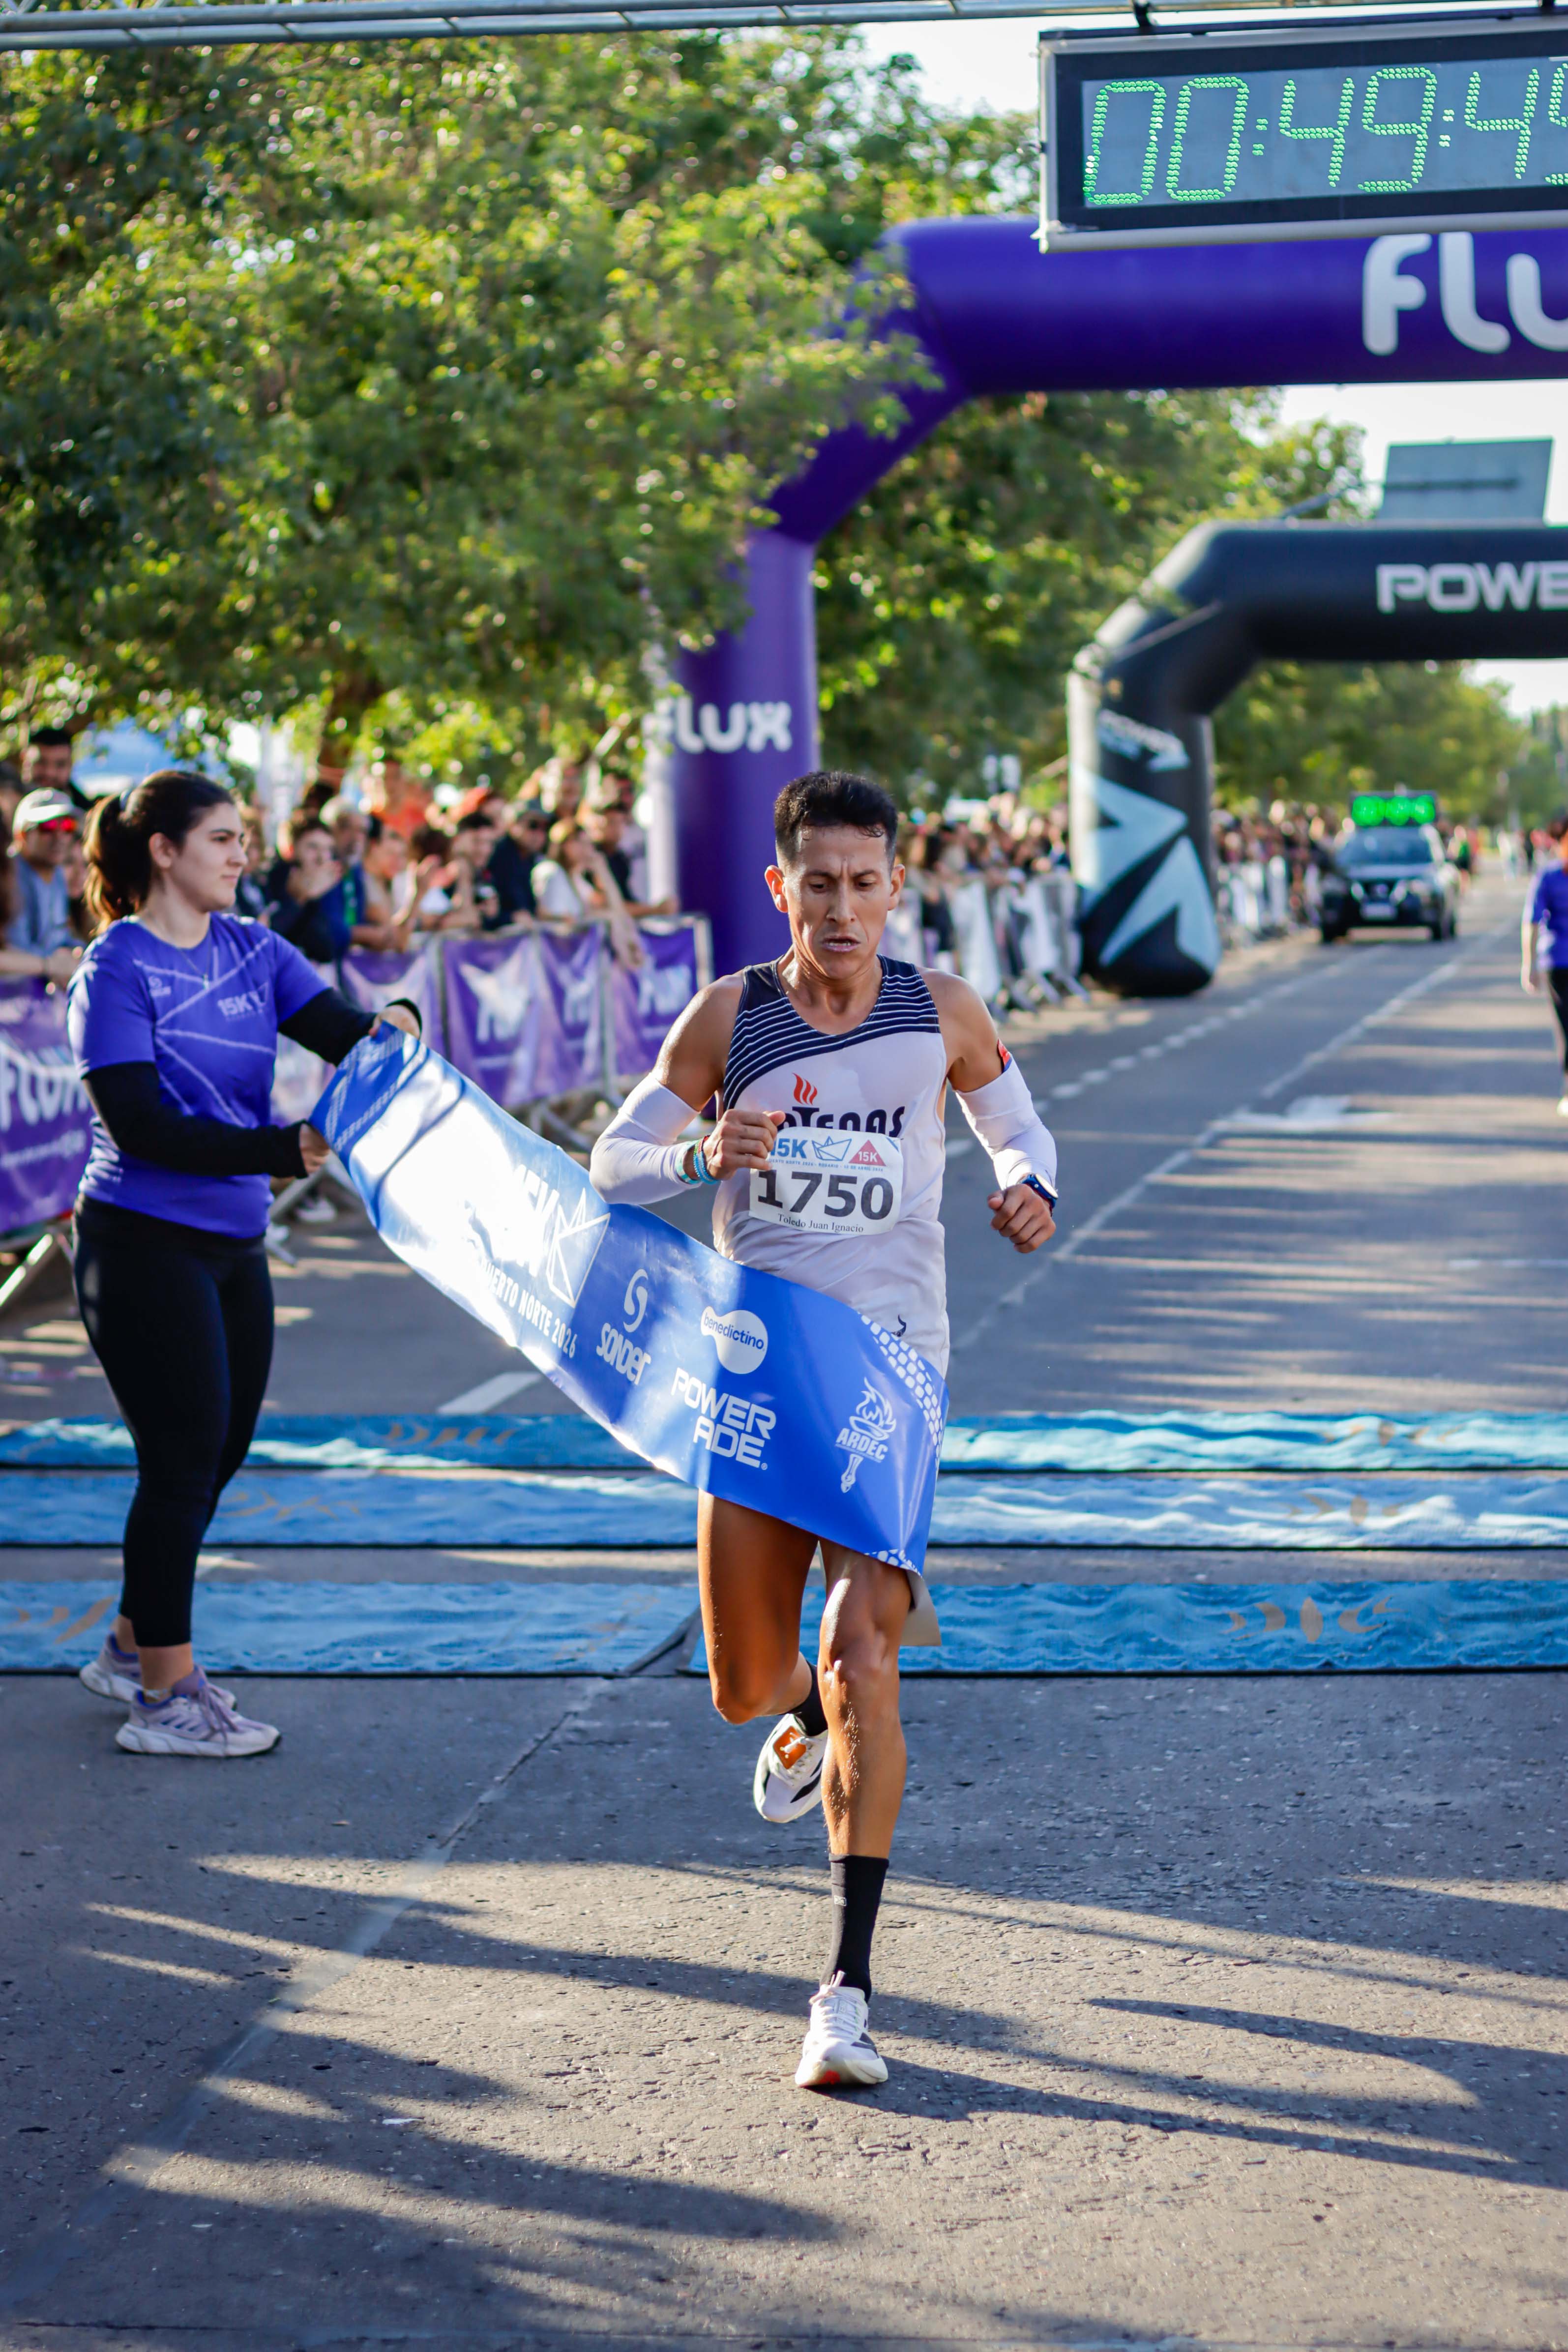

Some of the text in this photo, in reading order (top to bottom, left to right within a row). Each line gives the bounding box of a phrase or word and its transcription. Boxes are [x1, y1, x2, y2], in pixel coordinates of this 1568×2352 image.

[858, 1151, 878, 1163] 15K
[757, 1170, 894, 1220] 1750
[778, 1213, 864, 1233] Toledo Juan Ignacio
[518, 1290, 553, 1337] NORTE
[551, 1318, 578, 1358] 2026
[704, 1312, 764, 1350] benedictino
[671, 1367, 777, 1440] POWER
[836, 1427, 888, 1460] ARDEC
